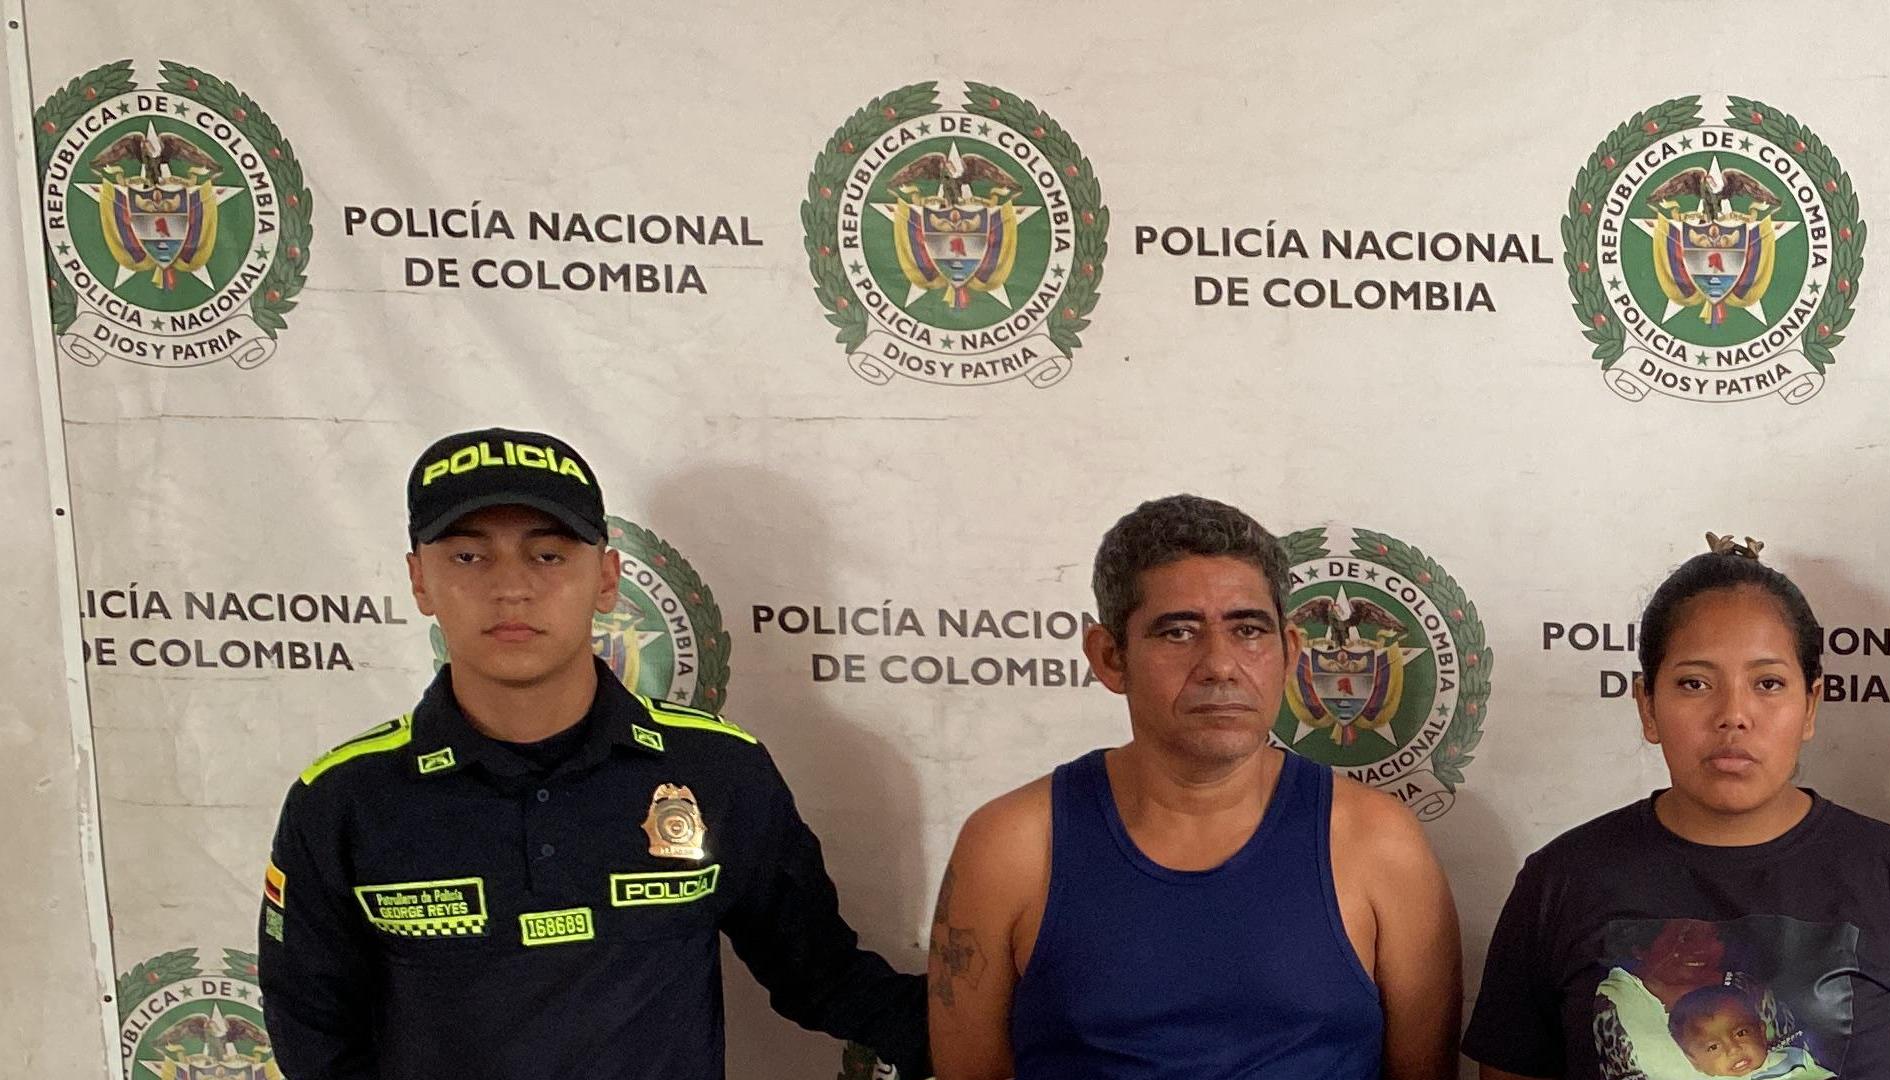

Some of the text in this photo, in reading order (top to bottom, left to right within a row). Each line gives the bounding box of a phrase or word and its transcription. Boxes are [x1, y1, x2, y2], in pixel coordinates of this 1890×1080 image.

[137, 96, 168, 112] DE
[197, 112, 275, 234] COLOMBIA
[941, 117, 972, 133] DE
[998, 132, 1070, 252] COLOMBIA
[1702, 131, 1734, 148] DE
[1759, 147, 1827, 268] COLOMBIA
[345, 201, 763, 245] POLICÍA NACIONAL
[1136, 220, 1553, 263] POLICÍA NACIONAL
[171, 257, 266, 331] NACIONAL
[406, 258, 707, 294] DE COLOMBIA
[1195, 277, 1496, 312] DE COLOMBIA
[960, 280, 1061, 350] NACIONAL
[1717, 296, 1818, 366] NACIONAL
[94, 324, 242, 360] DIOS Y PATRIA
[883, 343, 1038, 379] DIOS Y PATRIA
[1638, 359, 1792, 395] DIOS Y PATRIA
[422, 442, 590, 486] POLICÍA
[81, 582, 406, 624] ICÍA NACIONAL
[621, 559, 694, 677] COLOMBIA
[752, 600, 925, 638] POLICÍA
[1329, 562, 1455, 692] DE COLOMBIA
[1543, 622, 1635, 651] POLI
[130, 639, 354, 671] COLOMBIA
[812, 654, 867, 683] DE
[428, 901, 468, 917] REYES
[528, 914, 585, 938] 168689
[202, 980, 232, 997] DE
